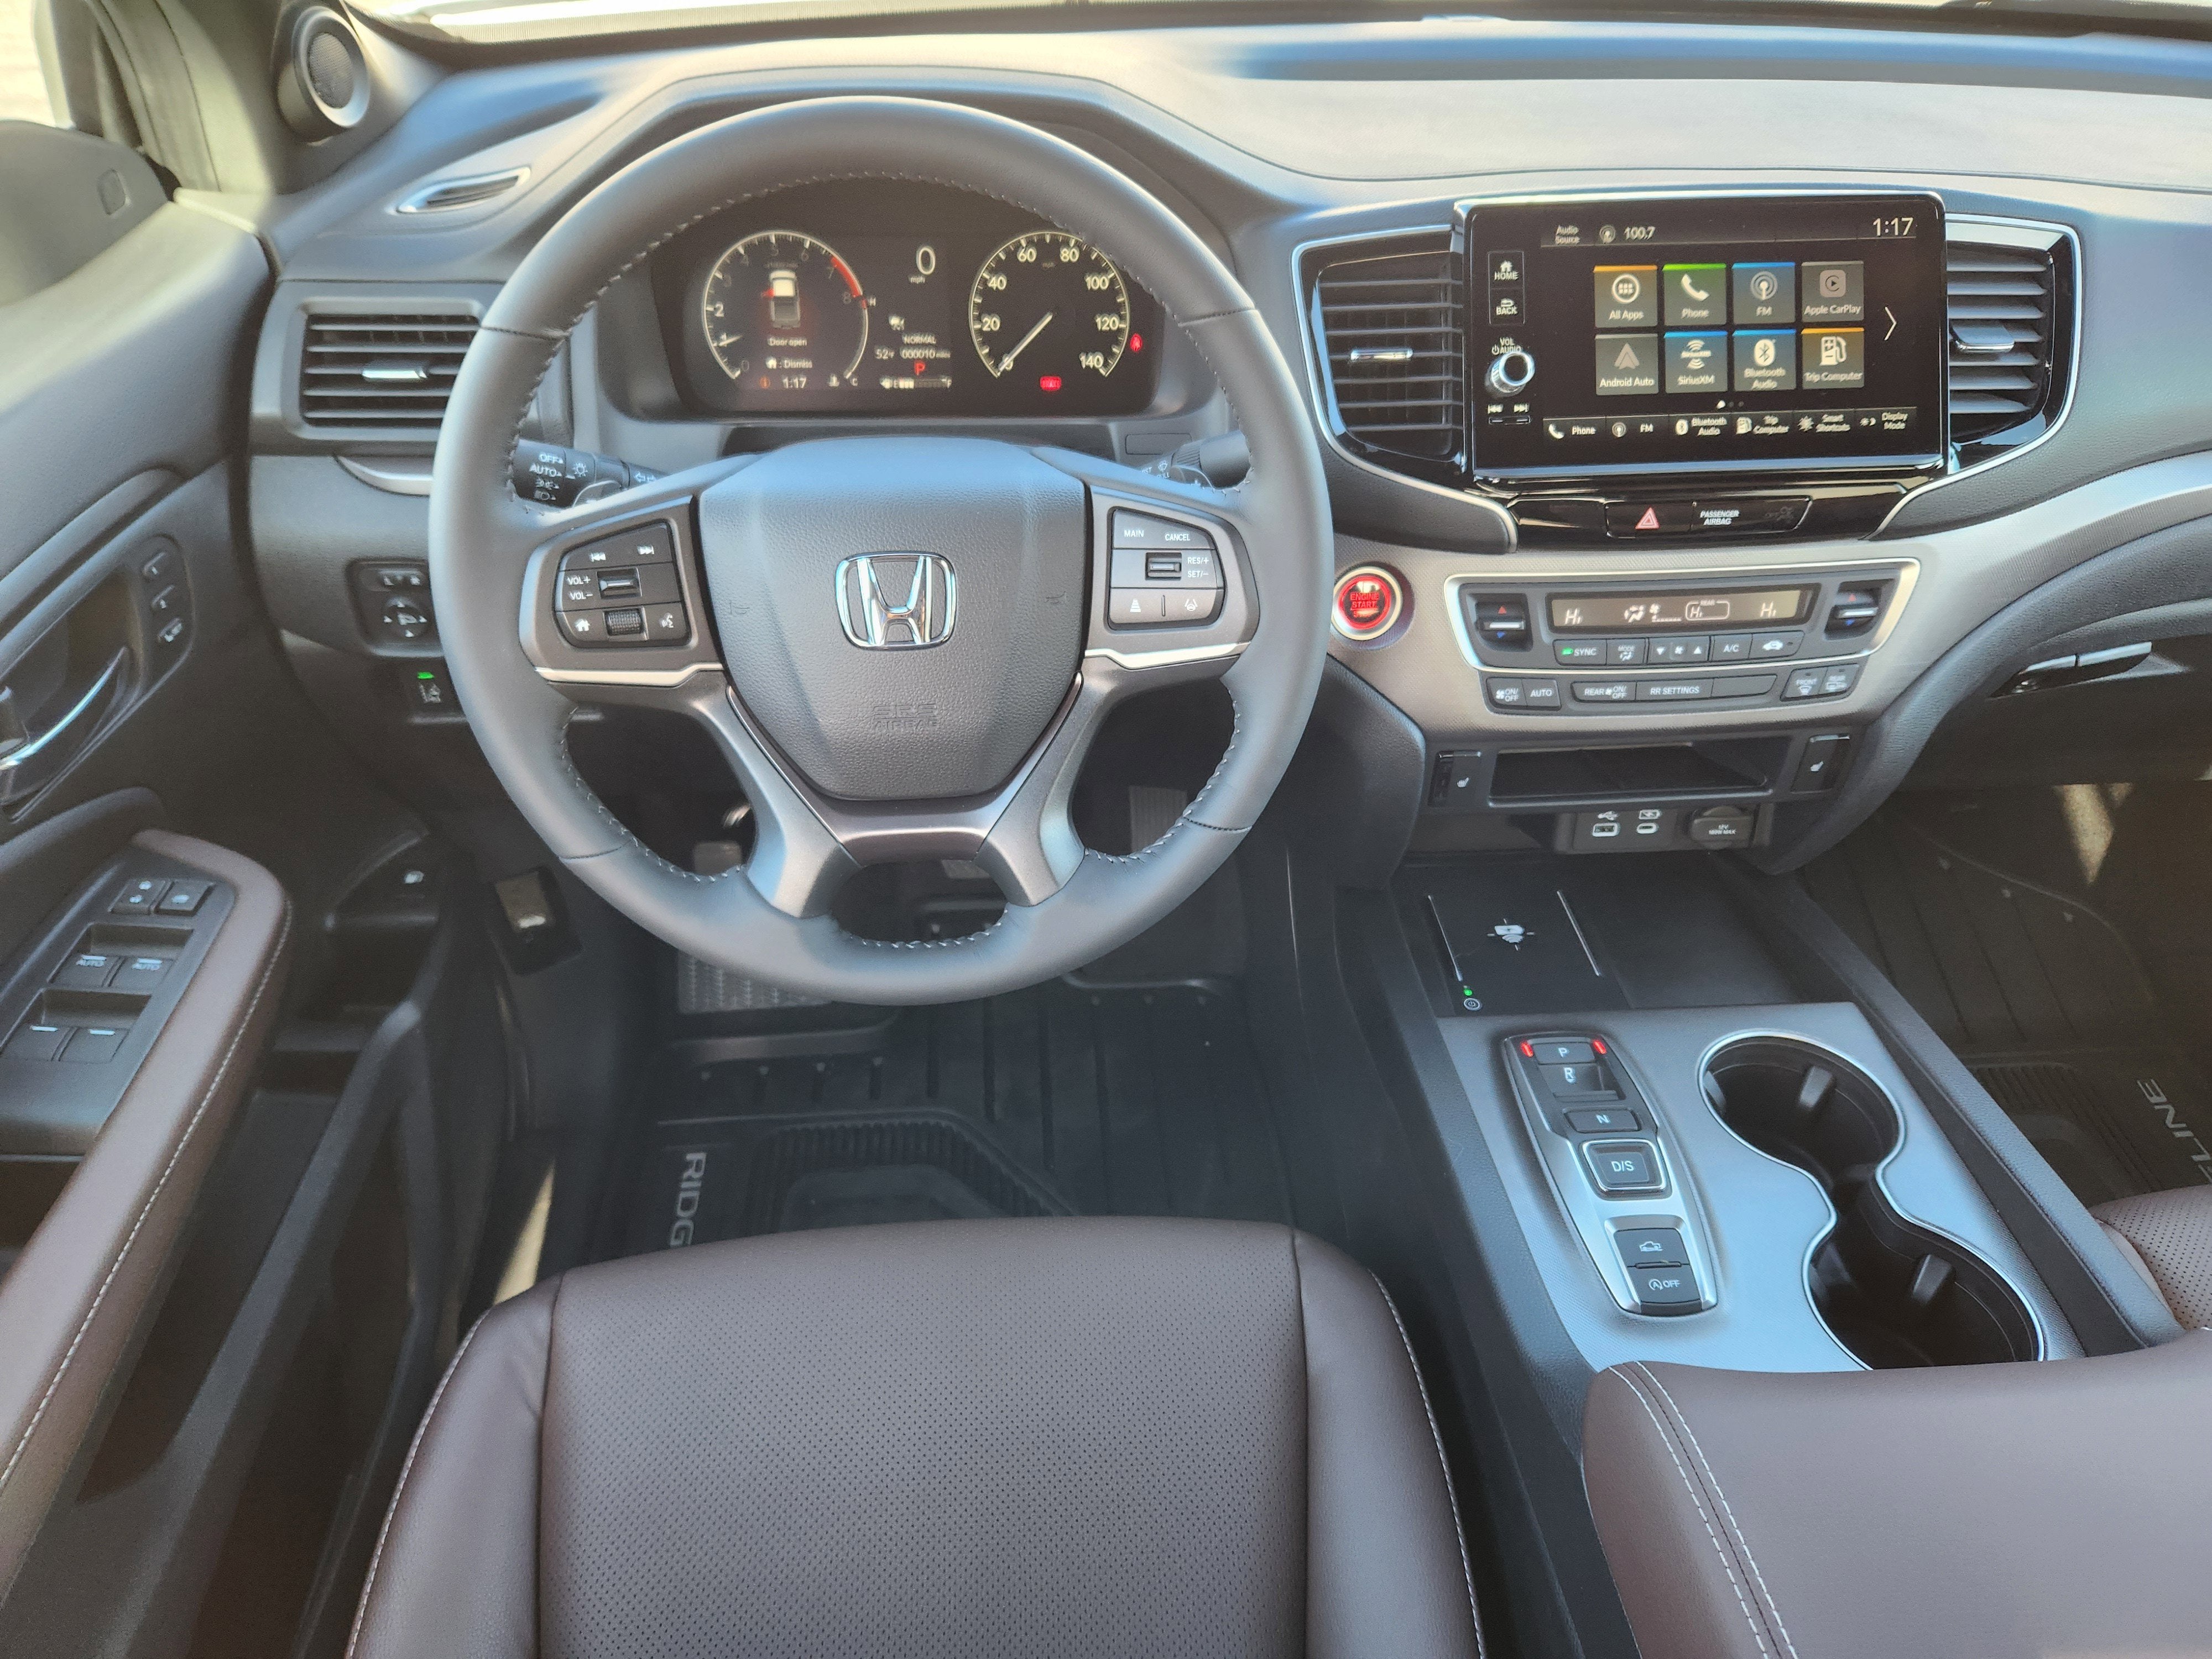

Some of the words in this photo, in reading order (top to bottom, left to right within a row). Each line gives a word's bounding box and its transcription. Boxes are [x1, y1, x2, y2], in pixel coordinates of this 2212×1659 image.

[1556, 225, 1579, 235] Audio
[1873, 217, 1913, 237] 1:17
[1624, 226, 1656, 240] 100.7
[1555, 235, 1580, 244] Source
[1017, 246, 1036, 263] 60
[1060, 246, 1079, 263] 80
[915, 245, 936, 275] 0
[909, 275, 926, 284] mph
[1494, 271, 1519, 280] HOME
[988, 274, 1006, 291] 40
[1085, 274, 1108, 290] 100
[714, 303, 724, 317] 2
[1496, 306, 1518, 315] BACK
[1681, 308, 1709, 320] Phone
[1756, 306, 1772, 316] FM
[1803, 305, 1828, 315] Apple
[1829, 305, 1861, 315] CarPlay
[1609, 310, 1621, 320] All
[1623, 310, 1644, 321] Apps
[981, 314, 1000, 331] 20
[1095, 314, 1119, 331] 120
[768, 338, 788, 346] Door
[788, 339, 807, 348] open
[902, 333, 937, 344] NORMAL
[1500, 337, 1514, 346] VOL
[900, 347, 936, 359] 000010
[1500, 346, 1521, 354] AUDIO
[783, 359, 813, 369] Dismiss
[1079, 352, 1103, 369] 140
[915, 361, 926, 375] P
[1744, 368, 1786, 378] Bluetooth
[1678, 375, 1715, 385] SiriusXM
[1804, 372, 1820, 382] Trip
[1821, 371, 1863, 382] Computer
[782, 378, 807, 389] 1:17
[1600, 378, 1632, 388] Android
[1634, 377, 1654, 387] Auto
[1751, 379, 1778, 390] Audio
[1692, 416, 1727, 426] Bluetooth
[1572, 425, 1596, 435] Phone
[1640, 424, 1653, 433] FM
[1698, 426, 1720, 436] Audio
[1753, 425, 1790, 435] Computer
[538, 452, 559, 463] OFF
[529, 463, 556, 477] AUTO
[567, 575, 591, 585] VOL+
[1350, 592, 1379, 601] ENGINE
[1574, 648, 1597, 656] SYNC
[1723, 644, 1739, 653] A/C
[1530, 690, 1552, 698] AUTO
[1663, 686, 1700, 695] SETTINGS
[1558, 1048, 1569, 1057] P
[1564, 1067, 1574, 1079] R
[1597, 1115, 1610, 1123] N
[1611, 1161, 1634, 1172] D/S
[670, 1152, 707, 1248] RIDG
[1663, 1280, 1681, 1288] OFF
